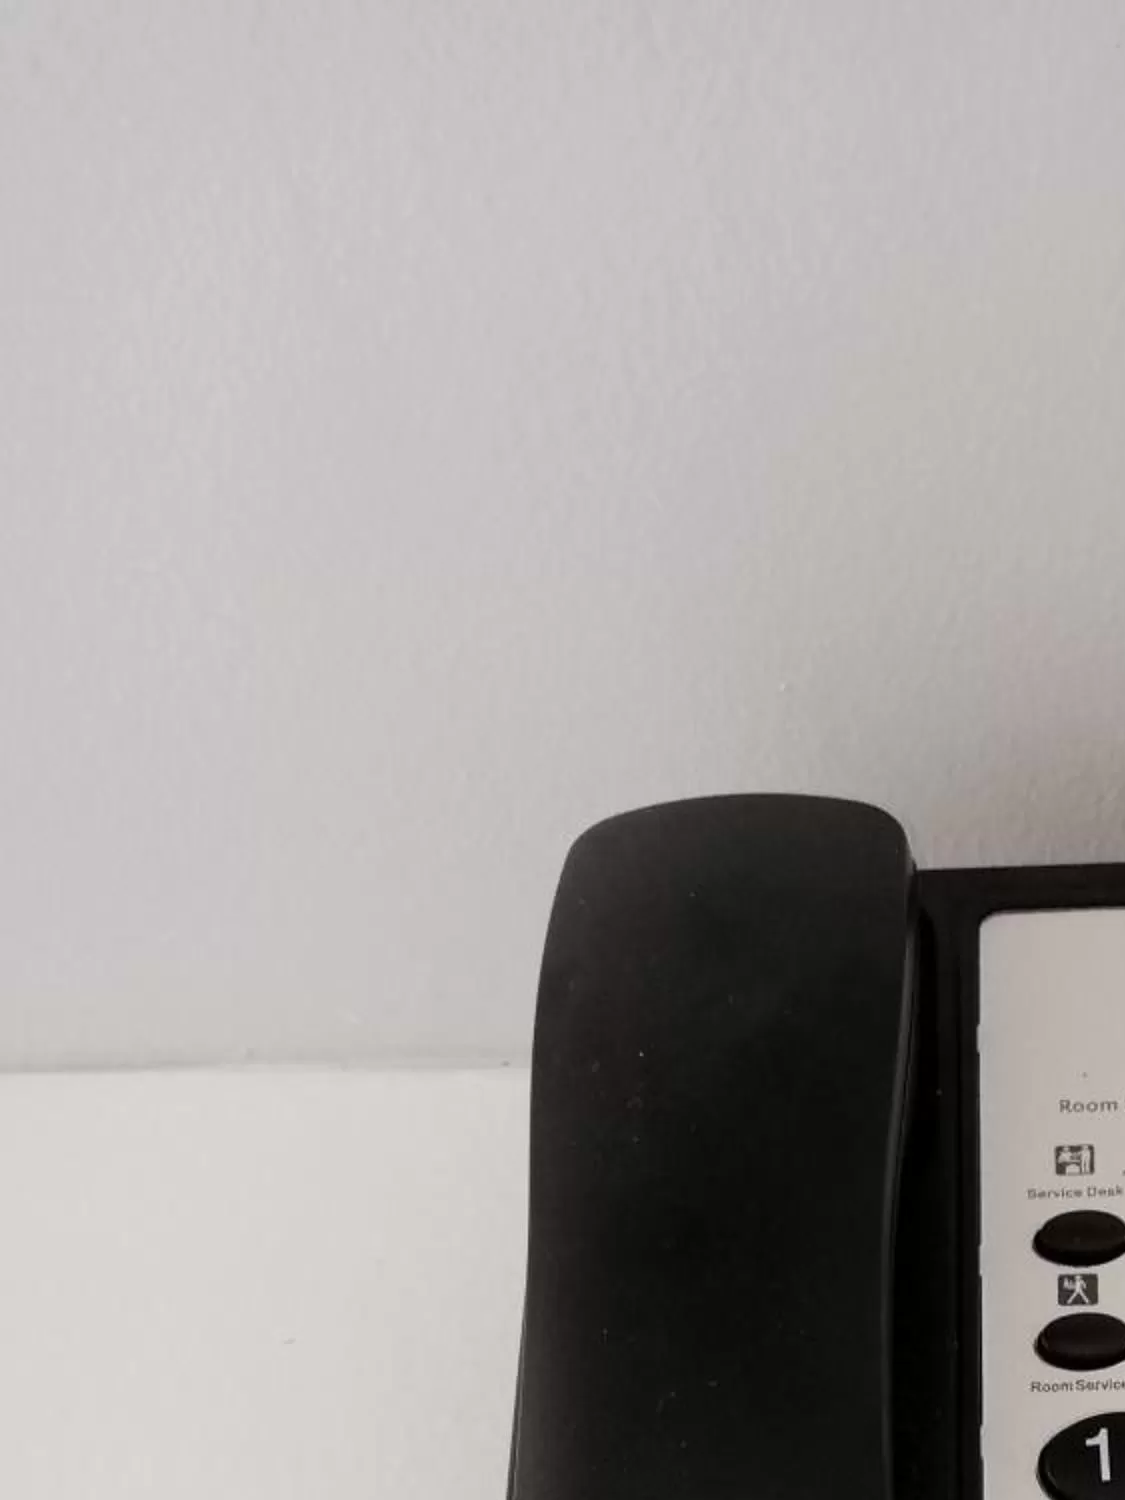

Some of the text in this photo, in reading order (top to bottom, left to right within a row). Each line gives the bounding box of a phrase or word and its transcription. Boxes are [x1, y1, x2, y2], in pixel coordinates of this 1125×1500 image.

[1058, 1097, 1119, 1114] Room
[1026, 1184, 1124, 1200] Service Desk
[1029, 1380, 1075, 1394] Room
[1085, 1427, 1111, 1483] 1
